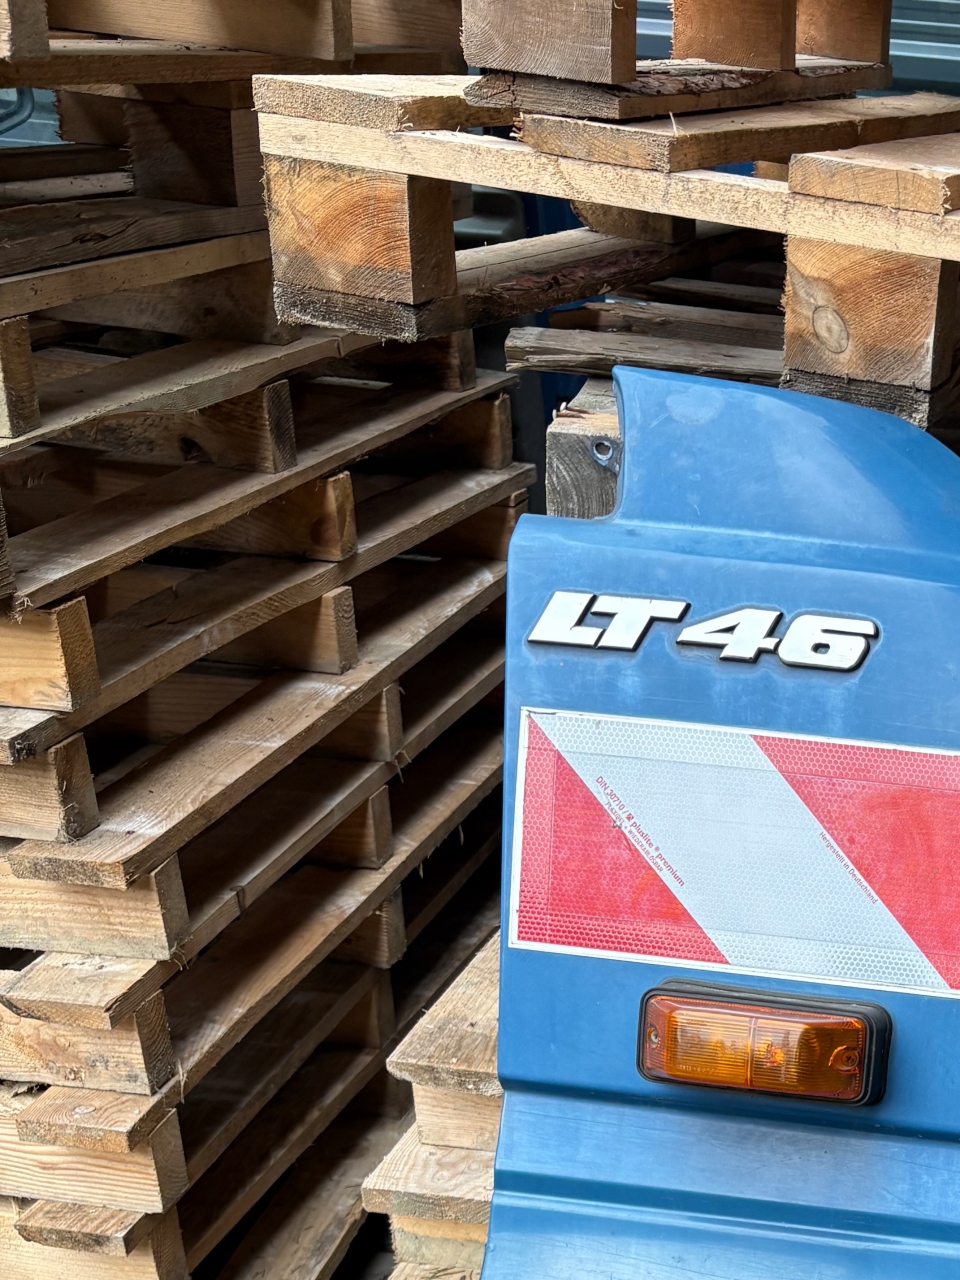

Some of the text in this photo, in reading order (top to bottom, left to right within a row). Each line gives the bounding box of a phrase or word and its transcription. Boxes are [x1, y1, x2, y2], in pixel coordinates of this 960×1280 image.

[527, 590, 880, 672] LT 46
[596, 776, 609, 791] DIN
[607, 789, 625, 811] 30710
[630, 821, 654, 848] pluslite
[655, 853, 685, 887] premium
[819, 831, 845, 863] Hergestellt
[849, 869, 878, 904] Deutschland
